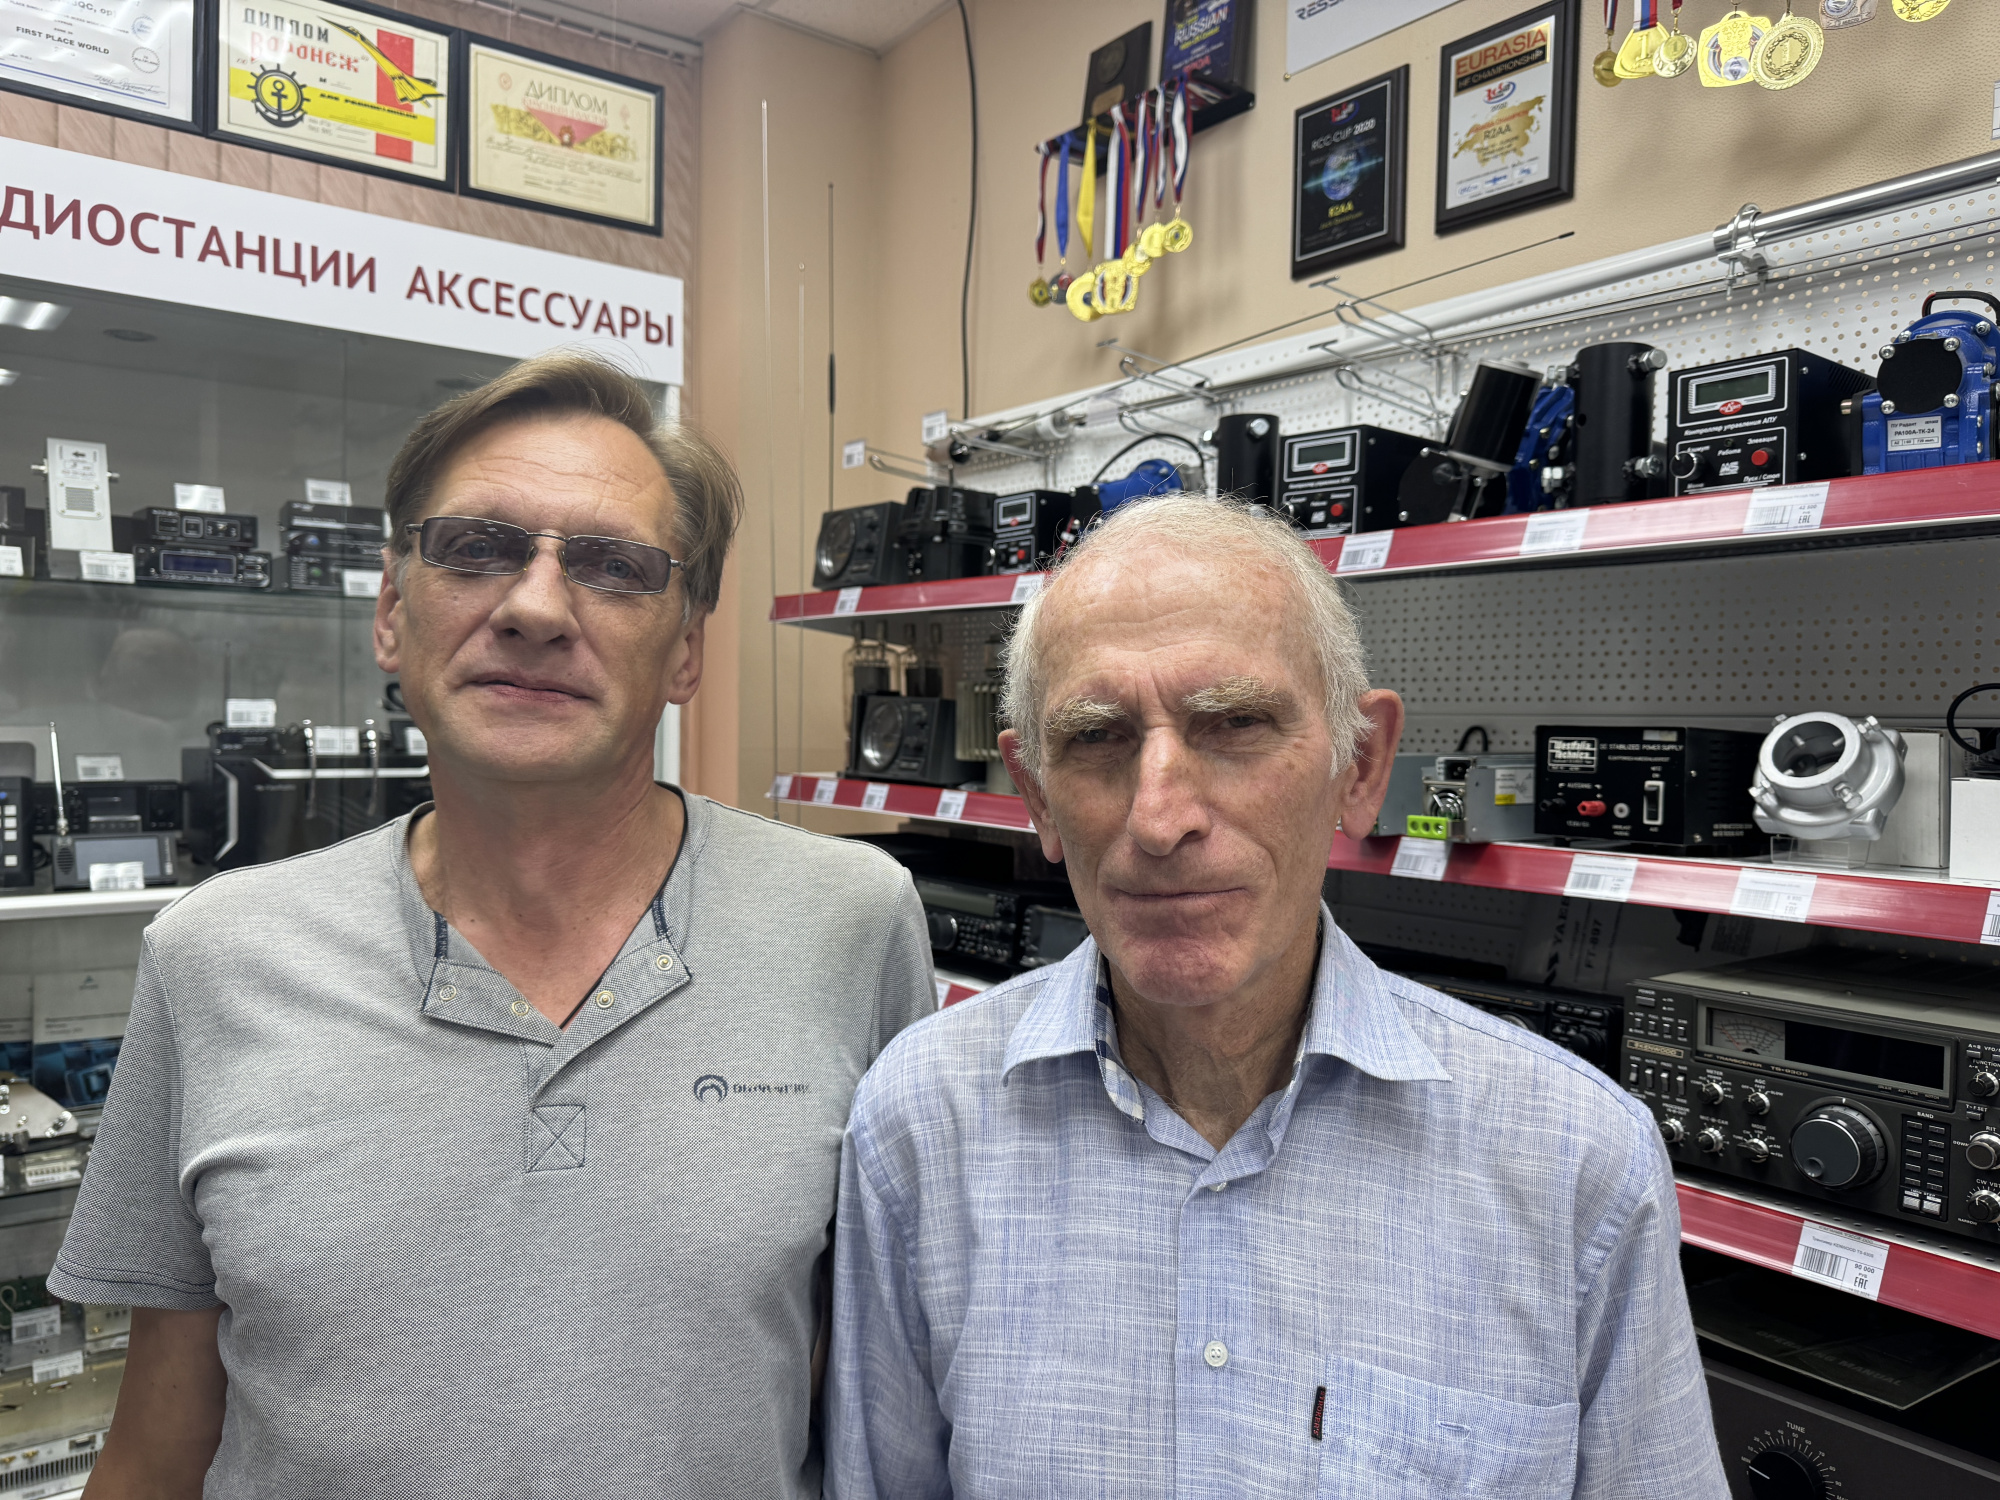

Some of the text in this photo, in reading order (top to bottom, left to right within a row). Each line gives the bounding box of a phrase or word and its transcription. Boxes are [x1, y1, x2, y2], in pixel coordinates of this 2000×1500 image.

[243, 7, 329, 44] ДИПЛОМ
[16, 26, 109, 55] FIRST PLACE WORLD
[1456, 29, 1546, 76] EURASIA
[1472, 49, 1543, 83] CHAMPIONSHIP
[525, 80, 608, 116] ДИПЛОМ
[406, 265, 673, 348] АКСЕССУАРЫ
[1684, 416, 1777, 436] Контроллер управления АПУ
[1553, 740, 1592, 750] Westfalia
[1608, 743, 1641, 751] STABILIZED
[1554, 750, 1591, 760] Technica
[1715, 1055, 1763, 1068] TRANSCEIVER
[1706, 1068, 1724, 1076] METER
[1917, 1111, 1934, 1119] BAND
[1833, 1243, 1856, 1253] KENWOOD
[1863, 1266, 1875, 1274] 000
[1838, 1360, 1906, 1387] MANUAL
[1786, 1421, 1806, 1434] TUNE
